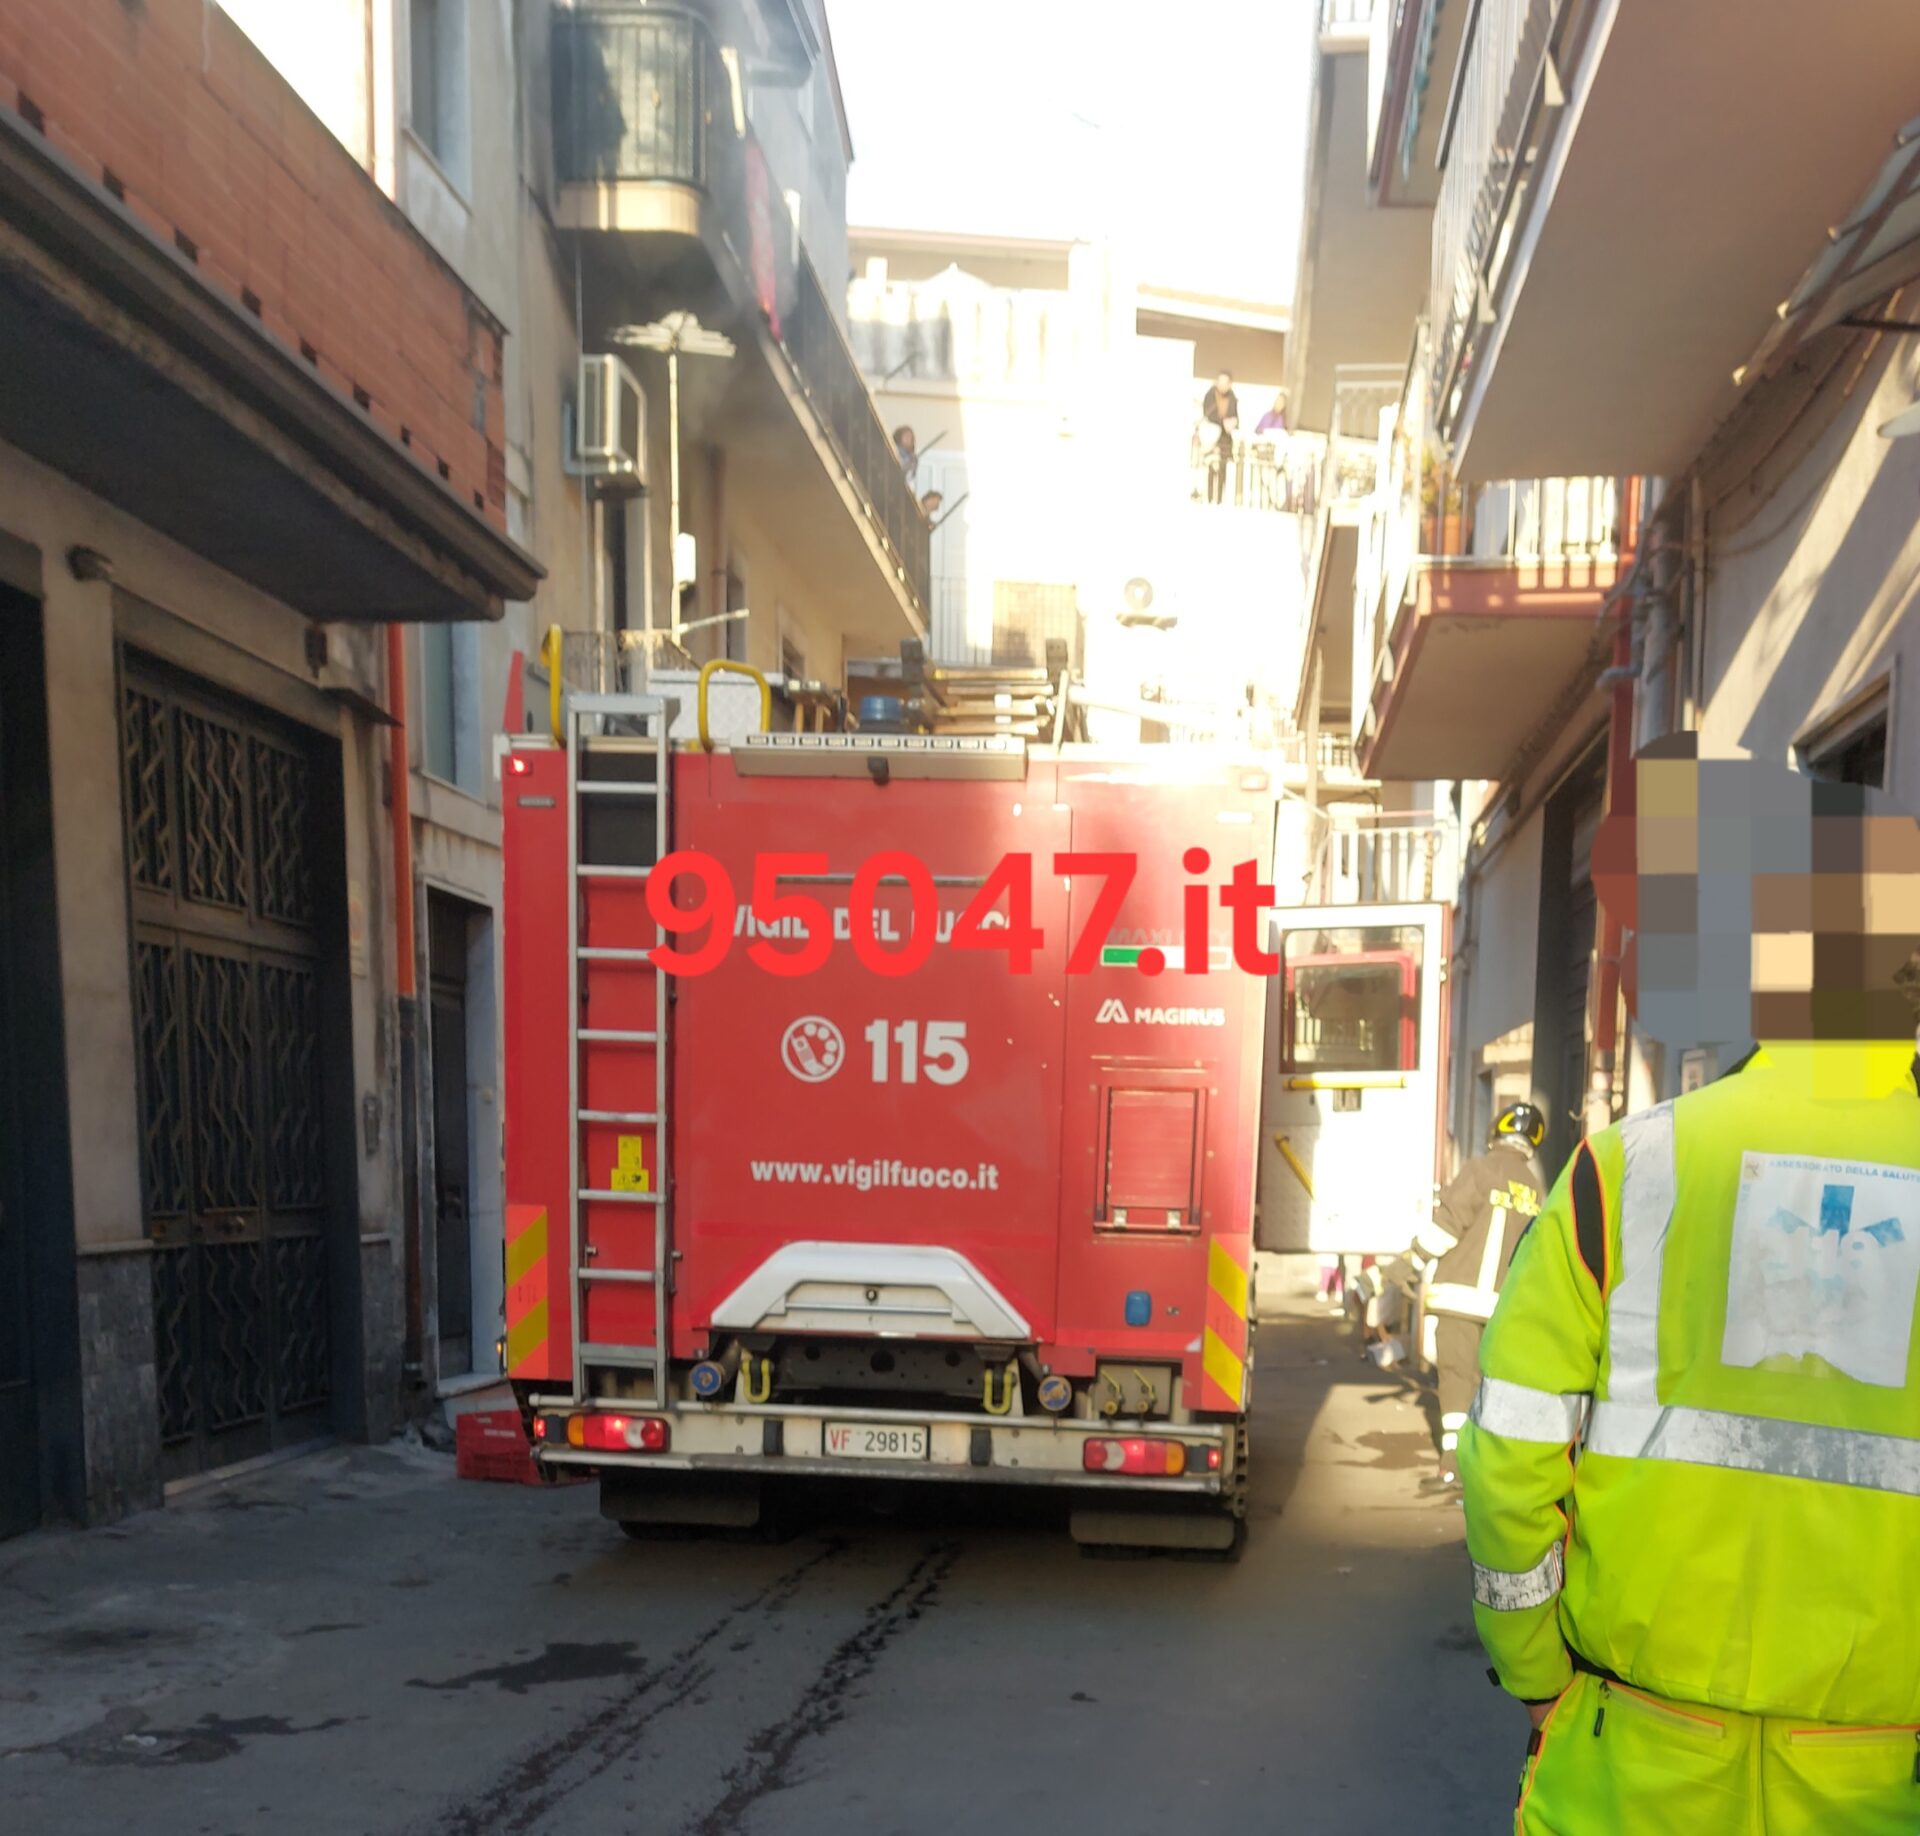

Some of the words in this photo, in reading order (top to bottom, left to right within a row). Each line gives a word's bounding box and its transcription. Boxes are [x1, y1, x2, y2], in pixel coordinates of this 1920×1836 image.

[1134, 1007, 1226, 1026] MAGIRUS
[865, 1019, 969, 1085] 115
[750, 1158, 999, 1191] www.vigilfuoco.it
[829, 1428, 851, 1451] VF
[864, 1430, 923, 1453] 29815
